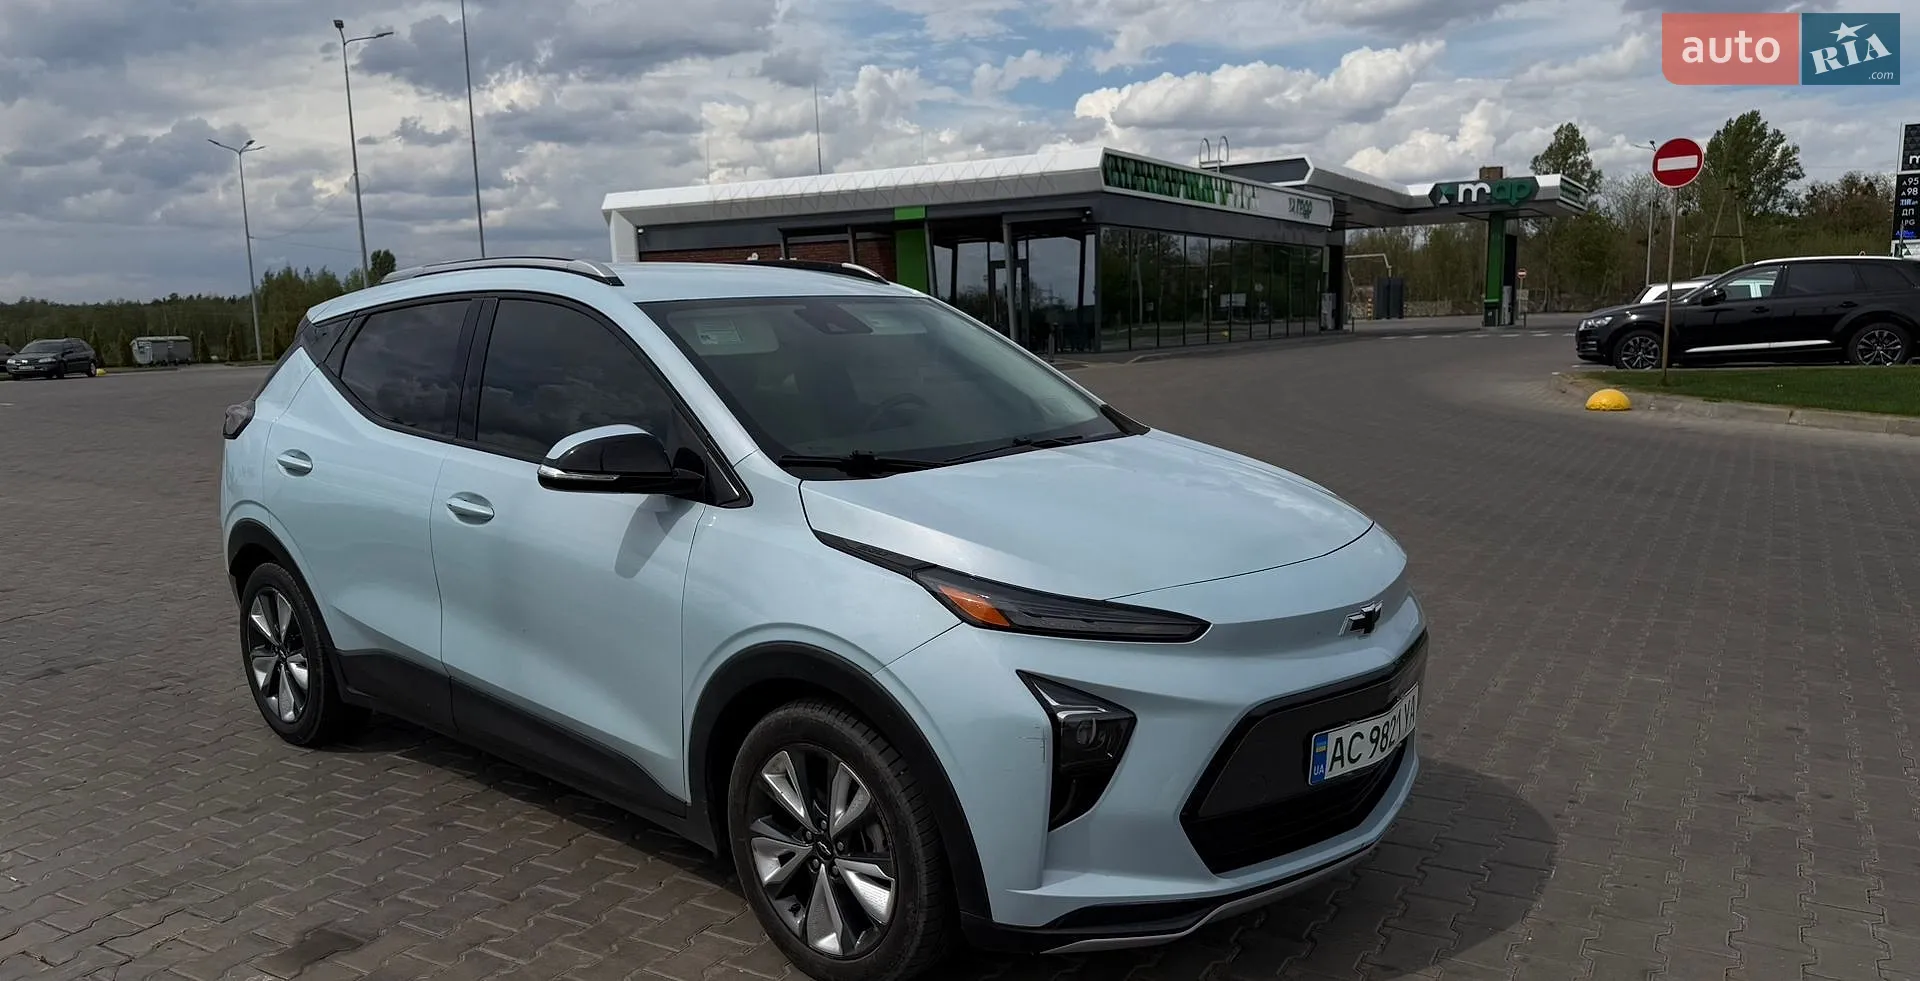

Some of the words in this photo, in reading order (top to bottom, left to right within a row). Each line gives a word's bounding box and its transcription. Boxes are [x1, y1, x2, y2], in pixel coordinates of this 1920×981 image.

[1329, 731, 1365, 772] AC
[1368, 708, 1402, 759] 9821
[1313, 764, 1325, 776] UA
